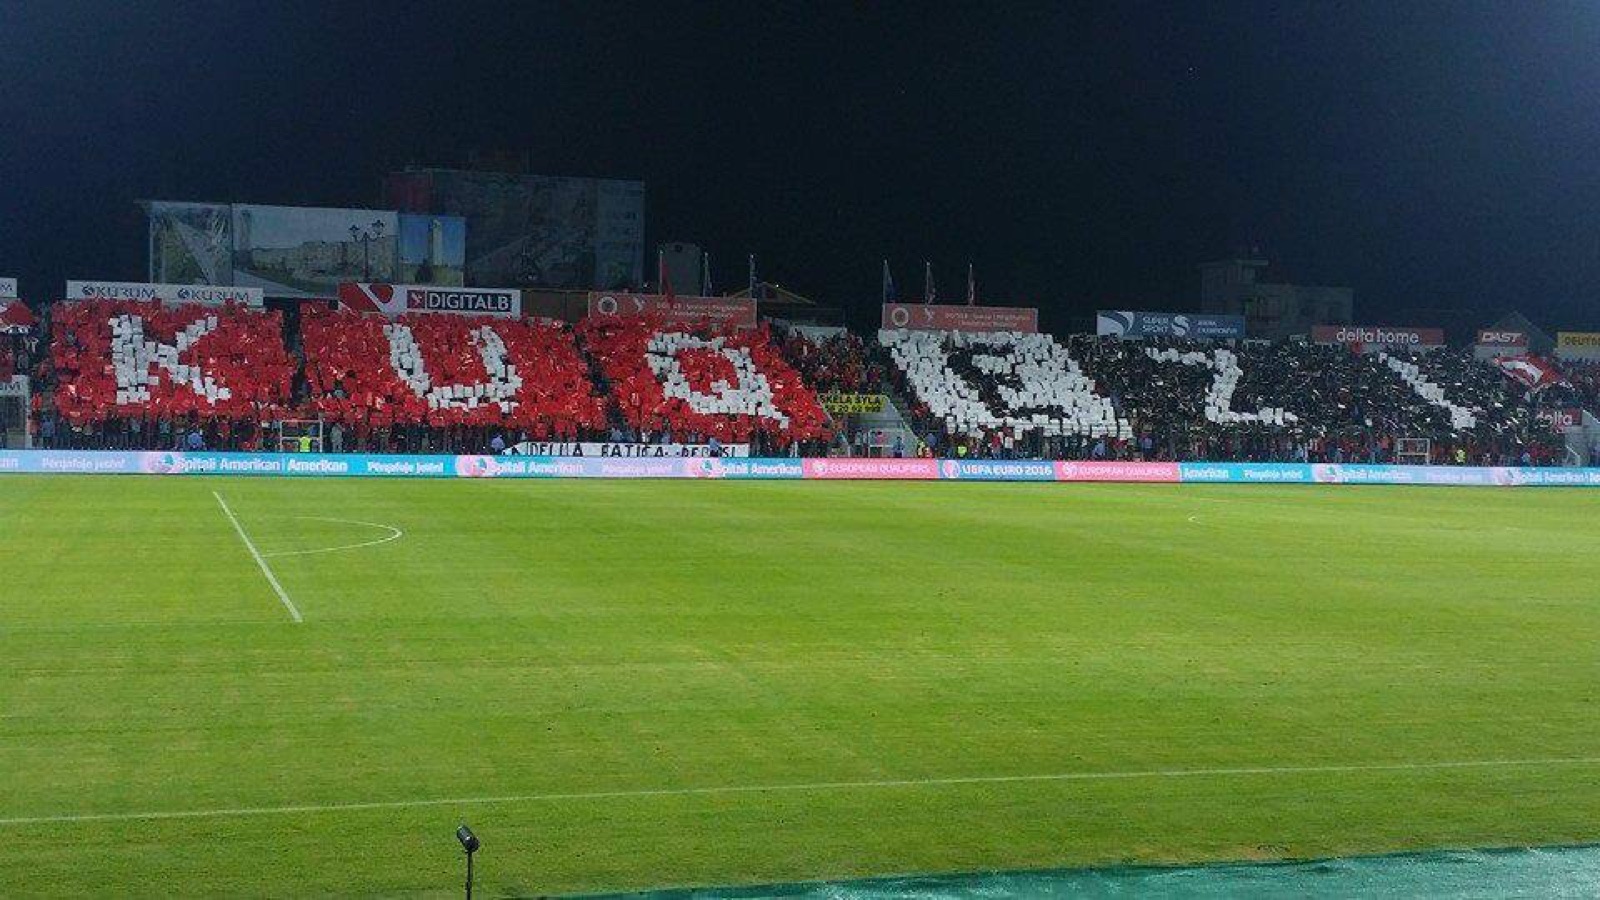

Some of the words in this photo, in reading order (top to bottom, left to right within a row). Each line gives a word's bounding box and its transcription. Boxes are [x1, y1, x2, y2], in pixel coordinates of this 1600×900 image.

[95, 286, 156, 300] KURUM
[191, 288, 249, 302] KURUM
[429, 291, 510, 310] DIGITALB
[1336, 328, 1374, 344] delta
[1376, 328, 1419, 344] home
[220, 458, 280, 471] Amerikan
[287, 459, 348, 472] Amerikan
[751, 463, 802, 475] Amerikan
[962, 464, 993, 476] UEFA
[993, 465, 1023, 476] EURO
[1024, 466, 1052, 476] 2016
